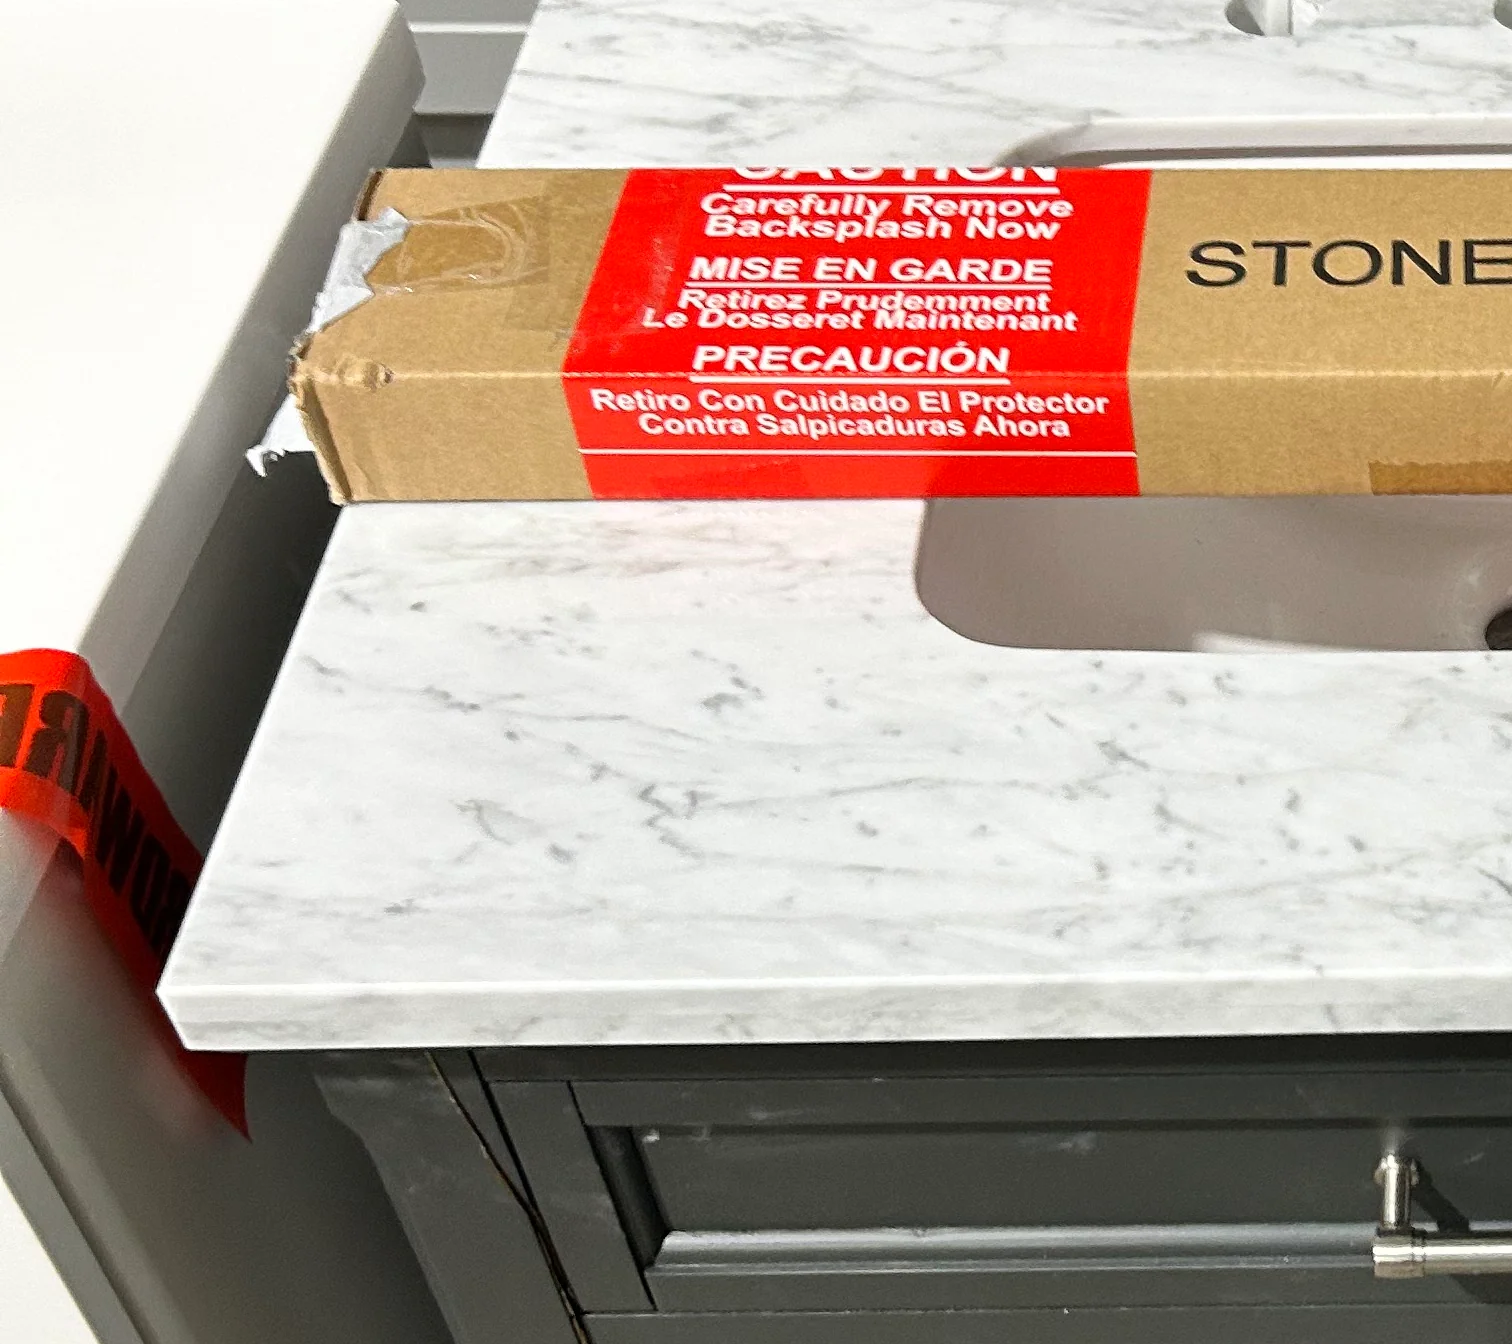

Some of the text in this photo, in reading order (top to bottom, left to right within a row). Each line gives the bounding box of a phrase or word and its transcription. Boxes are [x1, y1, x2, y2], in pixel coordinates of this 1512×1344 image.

[700, 191, 1075, 218] Carefully Remove
[704, 215, 1062, 243] Backsplash Now
[689, 256, 1054, 284] MISE EN GARDE
[678, 288, 1051, 313] Retirez Prudemment
[642, 307, 1078, 333] Le Dosseret Maintenant
[691, 340, 1011, 374] PRECAUCIÓN
[589, 388, 1110, 414] Retiro Con Cuidado El Protector
[637, 413, 1071, 441] Contra Salpicaduras Ahora
